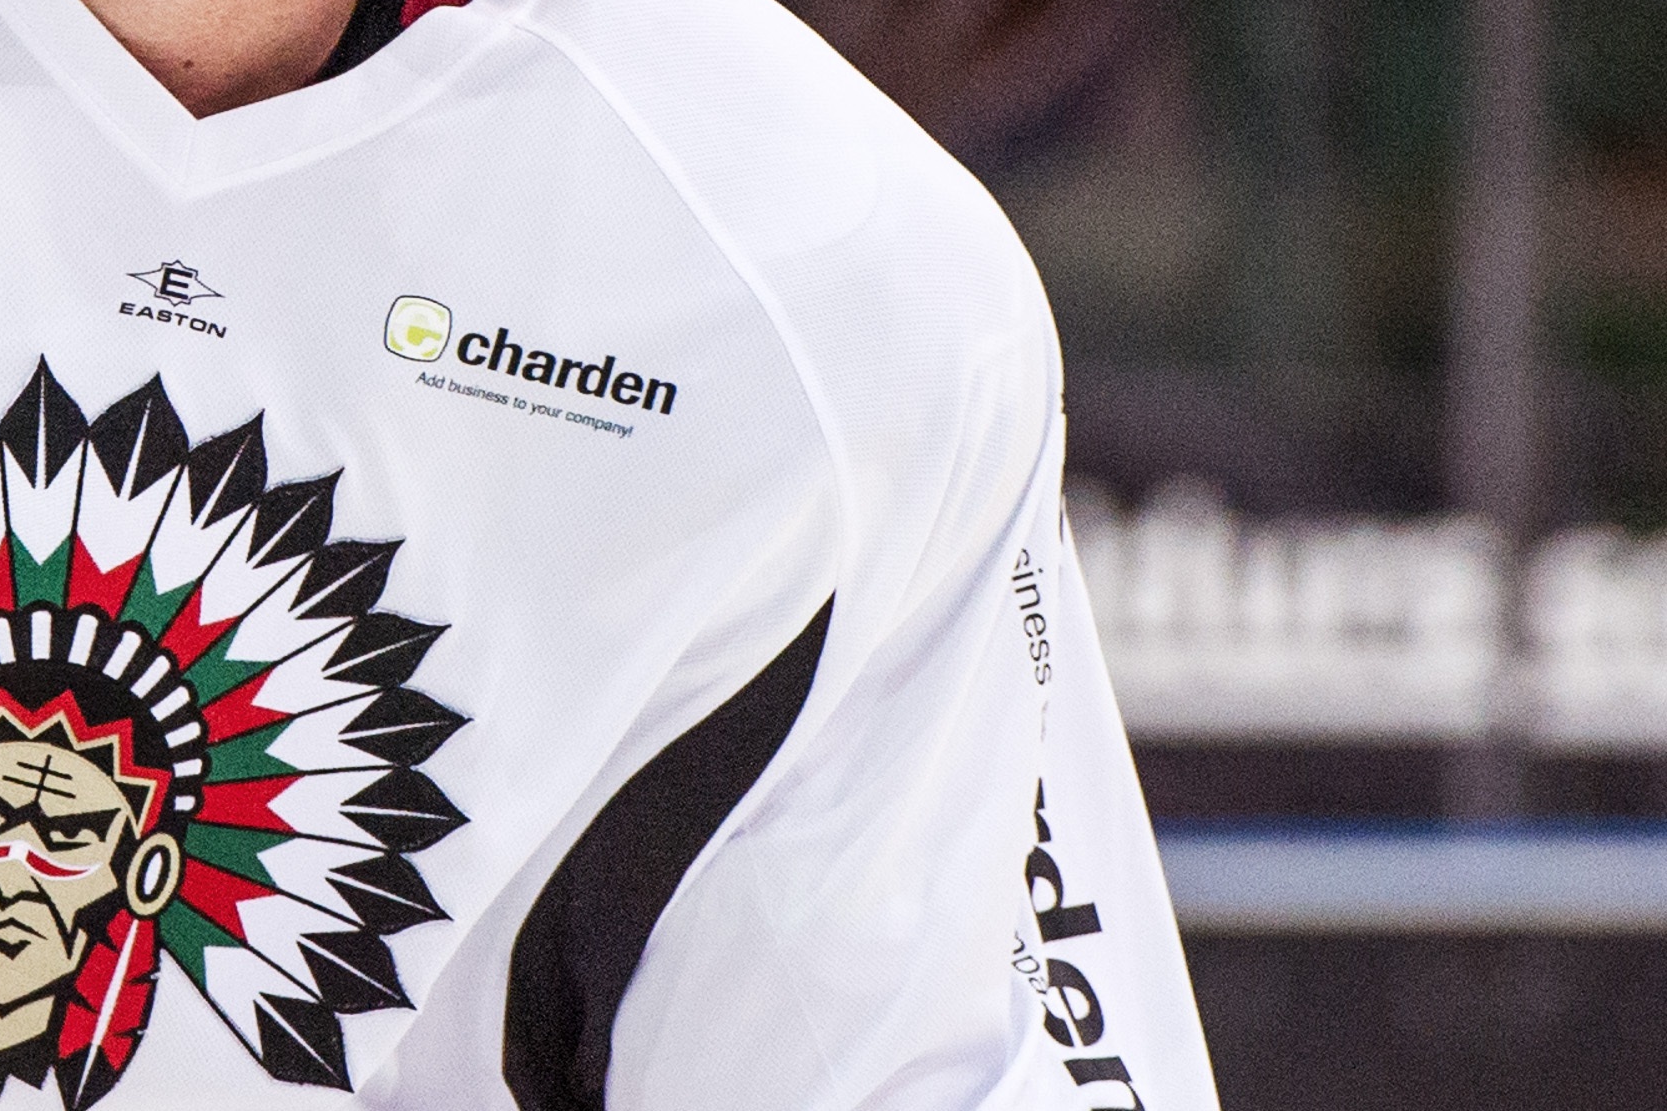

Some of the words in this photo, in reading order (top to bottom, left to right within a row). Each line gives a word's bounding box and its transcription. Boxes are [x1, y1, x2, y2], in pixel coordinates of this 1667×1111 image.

[119, 302, 227, 338] EASTON
[415, 371, 444, 390] Add
[449, 379, 508, 405] business
[513, 397, 526, 410] to
[531, 402, 562, 420] your
[565, 409, 634, 439] company!
[457, 328, 677, 415] charden
